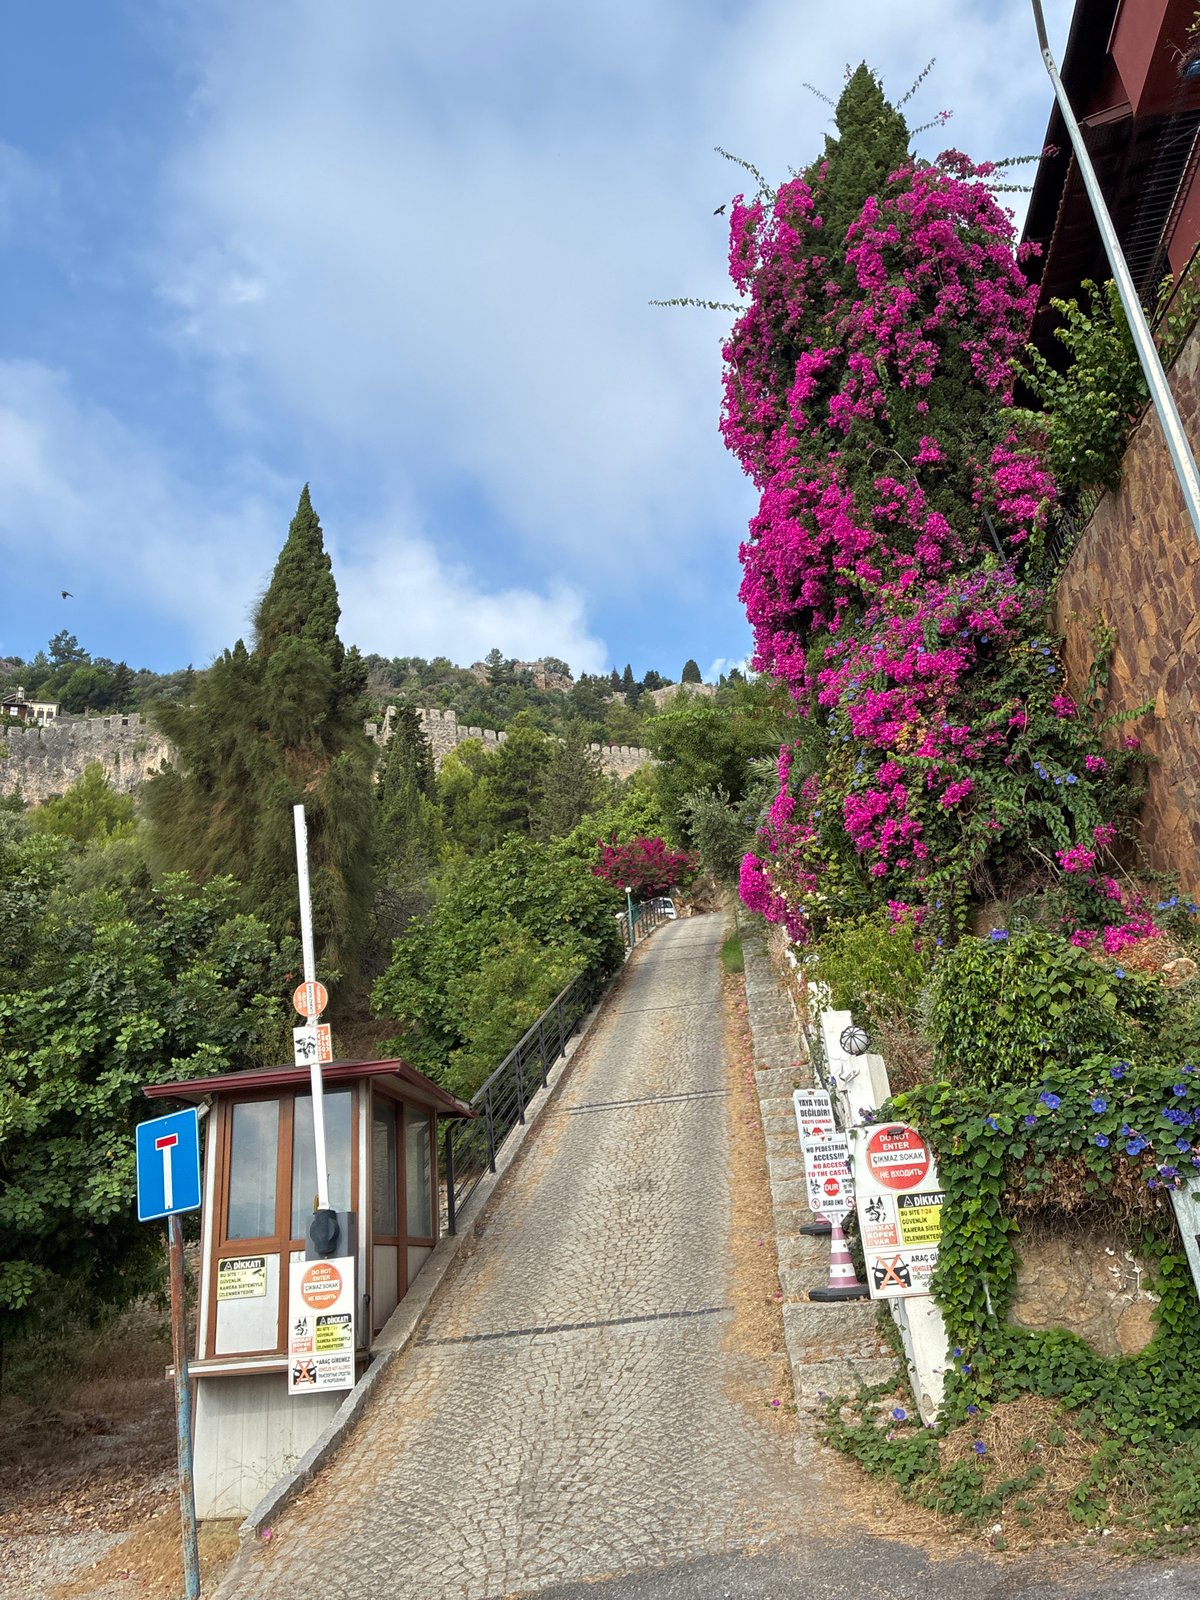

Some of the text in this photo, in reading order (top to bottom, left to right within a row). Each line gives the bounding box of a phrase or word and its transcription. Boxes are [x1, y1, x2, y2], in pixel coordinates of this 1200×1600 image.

[893, 1132, 910, 1140] NOT
[882, 1142, 910, 1150] ENTER
[814, 1152, 844, 1162] ACCESS!!!
[873, 1152, 924, 1164] ÇIKMAZ SOKAK
[890, 1168, 923, 1178] ВХОДИТЬ
[233, 1260, 262, 1270] DİKKAT!
